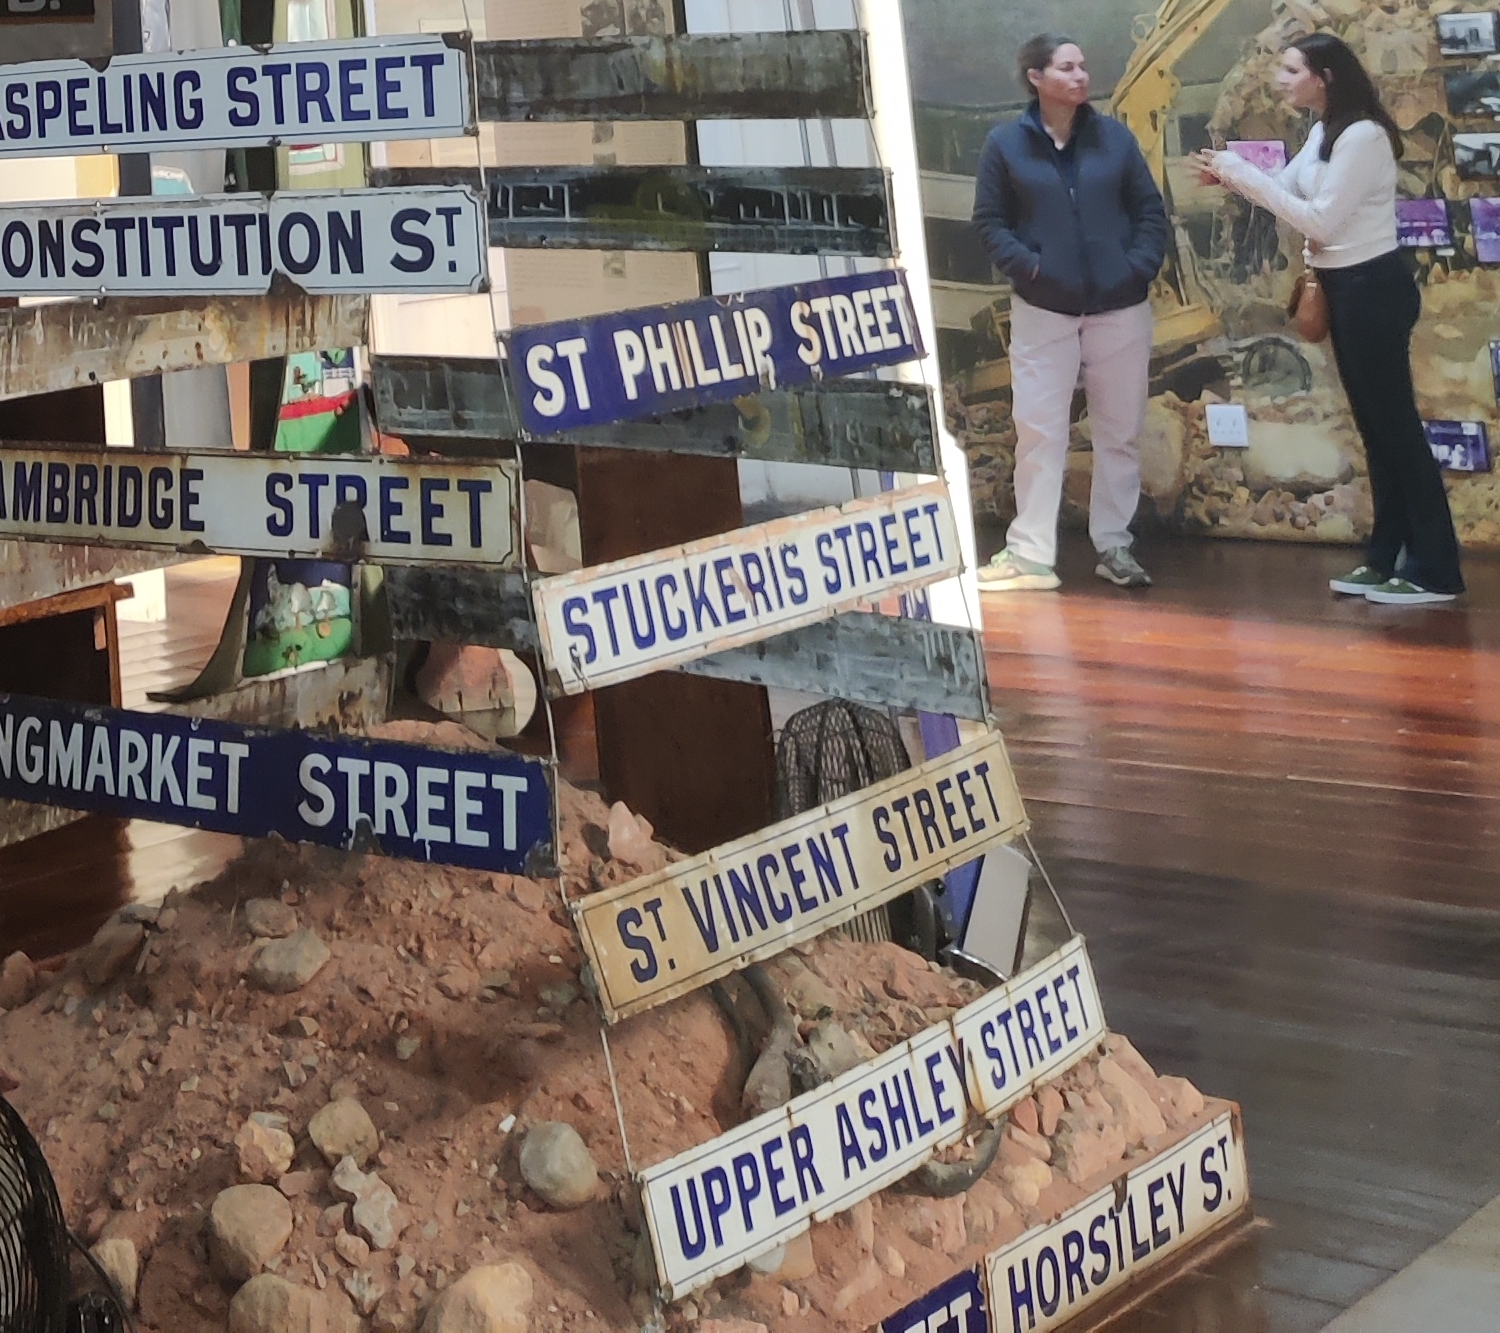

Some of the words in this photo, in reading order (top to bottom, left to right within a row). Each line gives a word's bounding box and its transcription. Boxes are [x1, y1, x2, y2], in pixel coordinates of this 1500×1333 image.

[227, 53, 445, 128] STREET
[525, 338, 592, 418] ST
[613, 307, 774, 401] PHILLIP
[789, 284, 913, 367] STREET
[265, 471, 494, 549] STREET
[561, 542, 809, 666] STUCKERIS
[816, 502, 947, 594] STREET
[297, 751, 529, 853] STREET
[683, 823, 862, 955] VINCENT
[871, 761, 1002, 875] STREET
[670, 1124, 826, 1262] UPPER
[835, 1038, 975, 1180] ASHLEY
[981, 965, 1094, 1089] STREET
